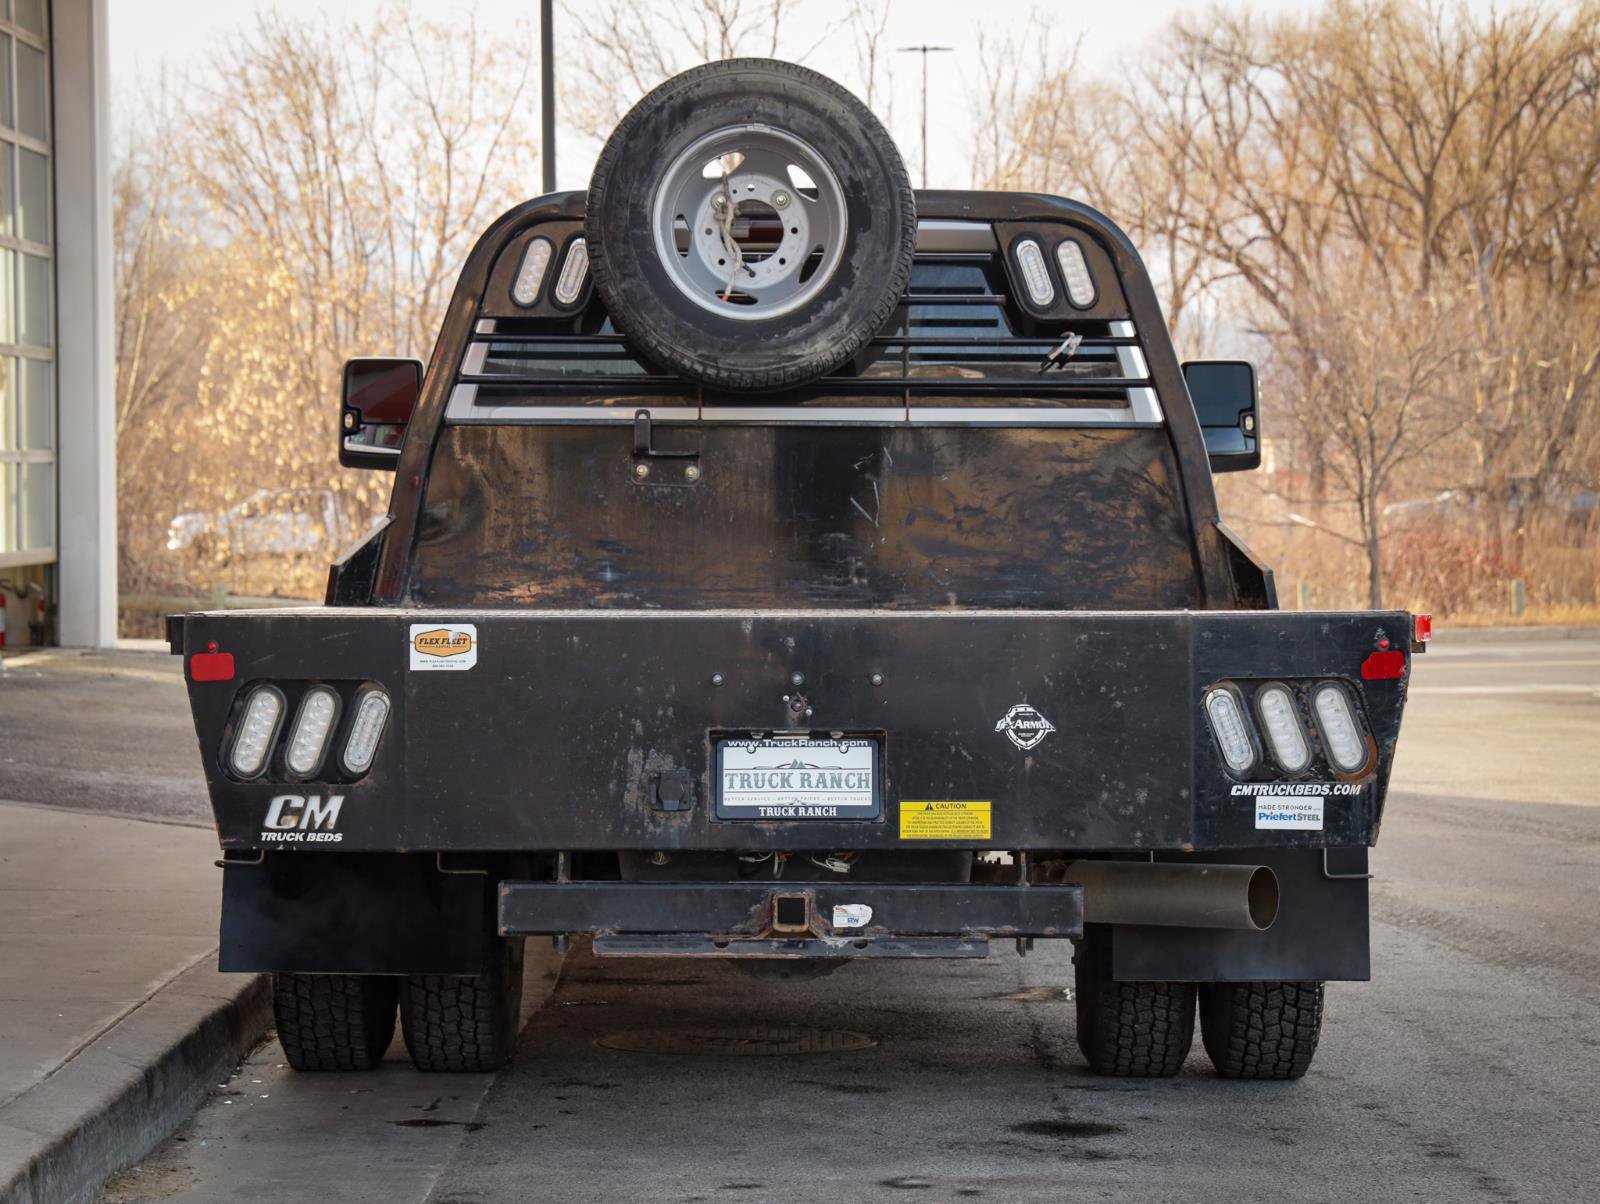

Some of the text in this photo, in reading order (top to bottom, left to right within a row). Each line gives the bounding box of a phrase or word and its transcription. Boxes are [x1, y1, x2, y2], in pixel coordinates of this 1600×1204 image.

[418, 637, 440, 645] FLEX
[727, 739, 869, 747] www.TruckRanch.com
[724, 772, 872, 789] TRUCK RANCH
[1231, 784, 1361, 796] CMTRUCKBEDS.COM
[264, 794, 345, 830] CM
[758, 806, 837, 817] TRUCK RANCH
[1258, 811, 1321, 821] Priefert STEEL
[261, 831, 344, 842] TRUCK BEDS
